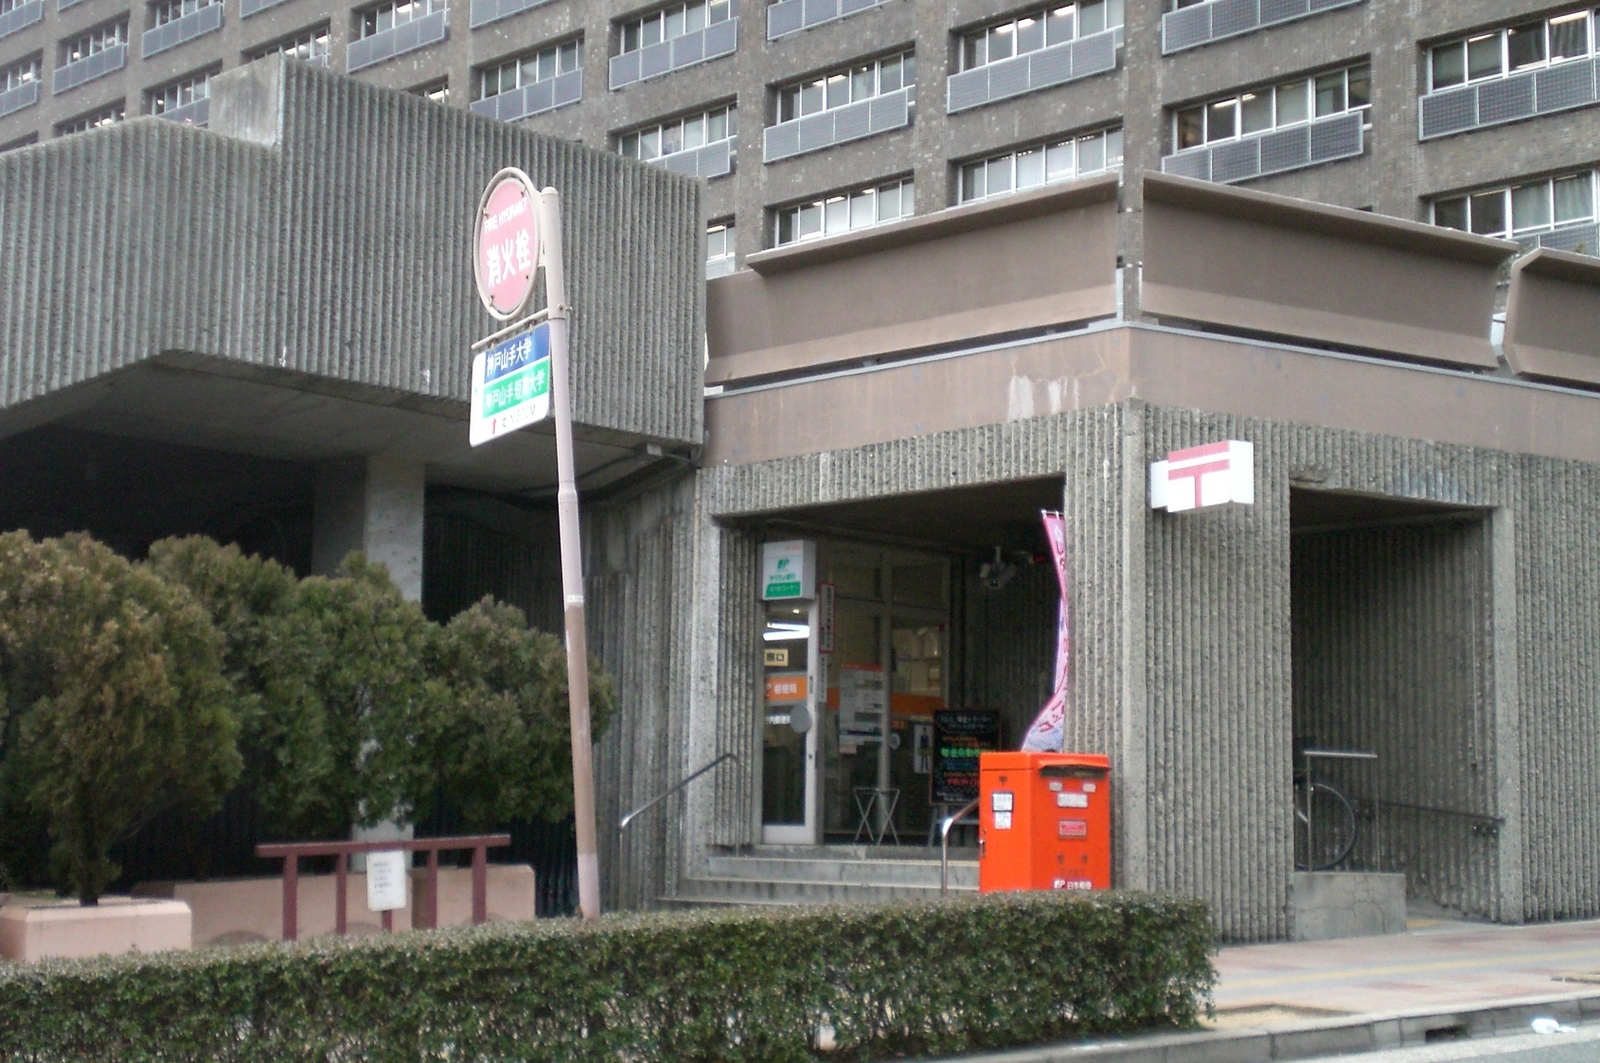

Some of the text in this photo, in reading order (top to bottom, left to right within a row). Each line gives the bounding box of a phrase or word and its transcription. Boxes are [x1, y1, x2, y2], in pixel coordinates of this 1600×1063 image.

[486, 228, 532, 288] 消火栓
[487, 336, 532, 377] 神戸山手大学
